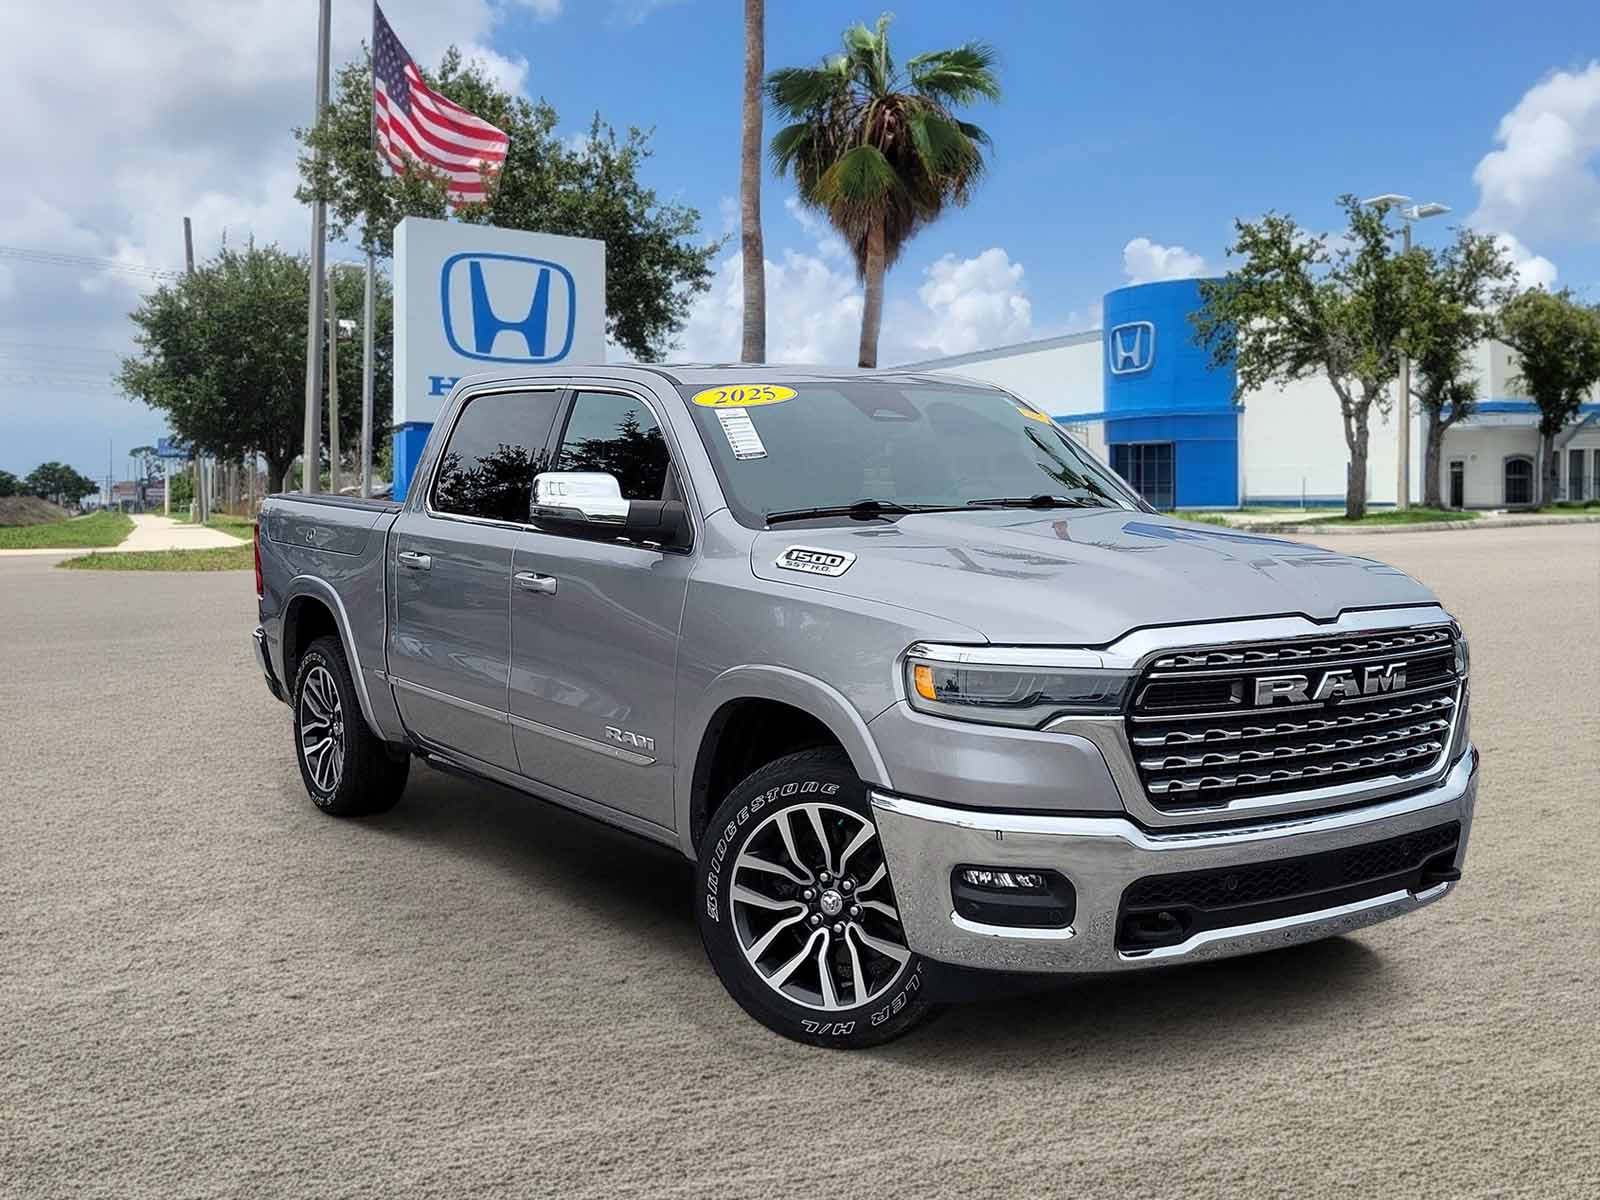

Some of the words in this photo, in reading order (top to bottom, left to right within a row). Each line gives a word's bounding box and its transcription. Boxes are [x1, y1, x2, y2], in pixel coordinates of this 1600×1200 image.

[713, 387, 776, 404] 2025
[790, 550, 843, 567] 1500
[1254, 662, 1407, 706] RAM
[605, 724, 655, 752] RAM
[706, 780, 840, 923] BRIDGESTONE
